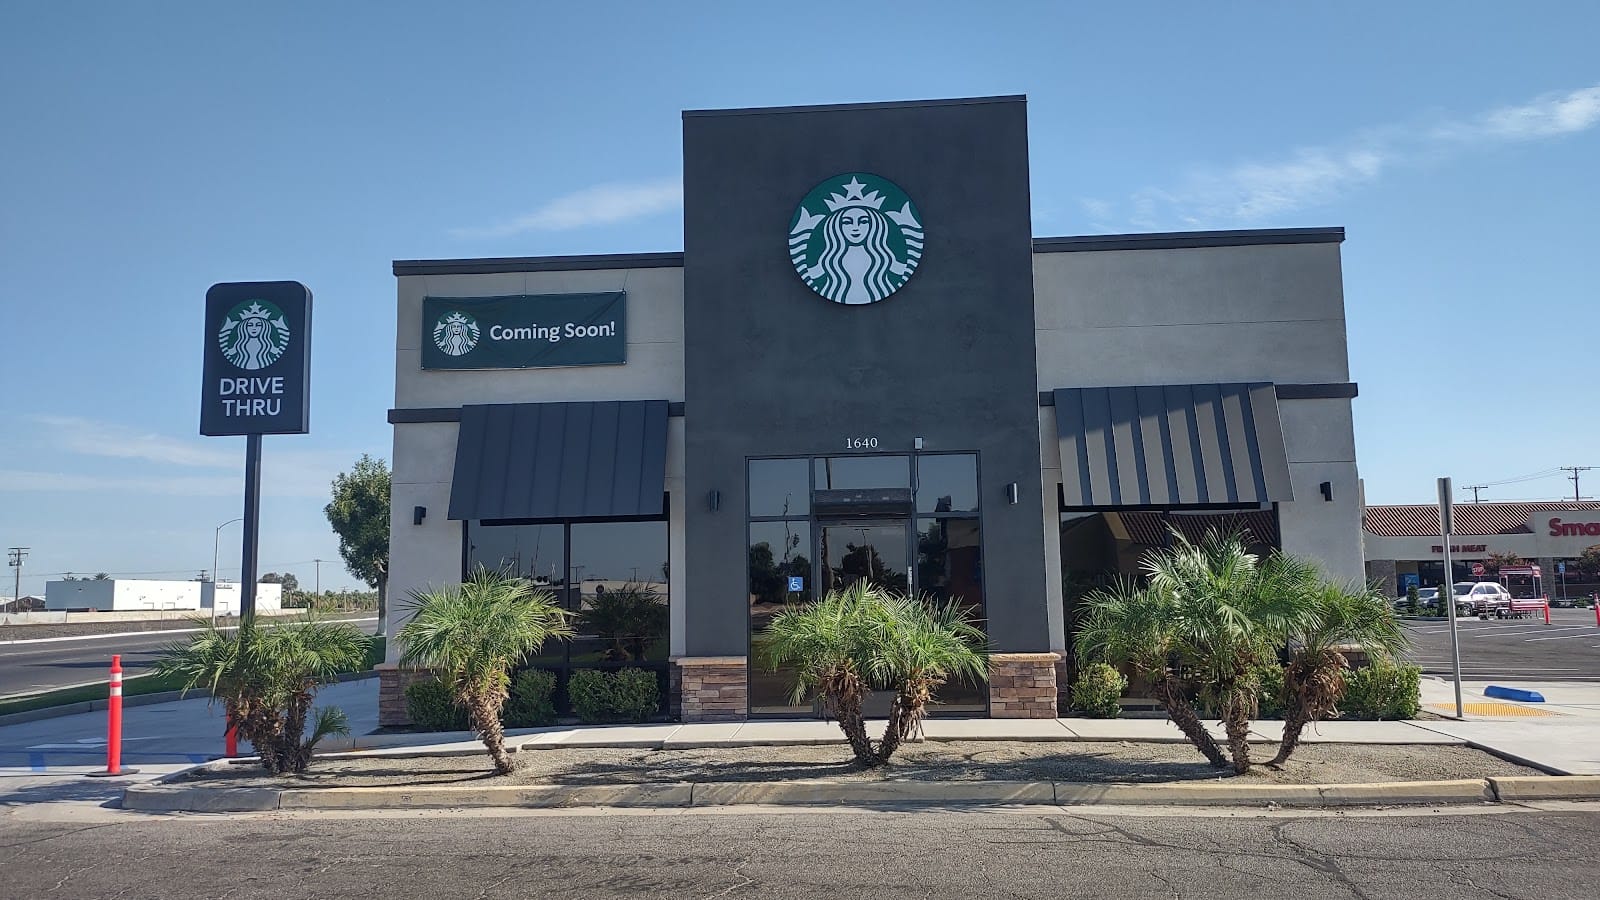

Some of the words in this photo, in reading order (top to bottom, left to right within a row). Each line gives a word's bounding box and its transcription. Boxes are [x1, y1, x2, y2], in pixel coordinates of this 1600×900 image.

[489, 323, 560, 343] Coming
[564, 321, 616, 339] Soon!
[219, 376, 284, 396] DRIVE
[221, 399, 281, 417] THRU
[846, 437, 878, 449] 1640
[1431, 545, 1460, 553] FRH
[1461, 544, 1487, 553] MEAT
